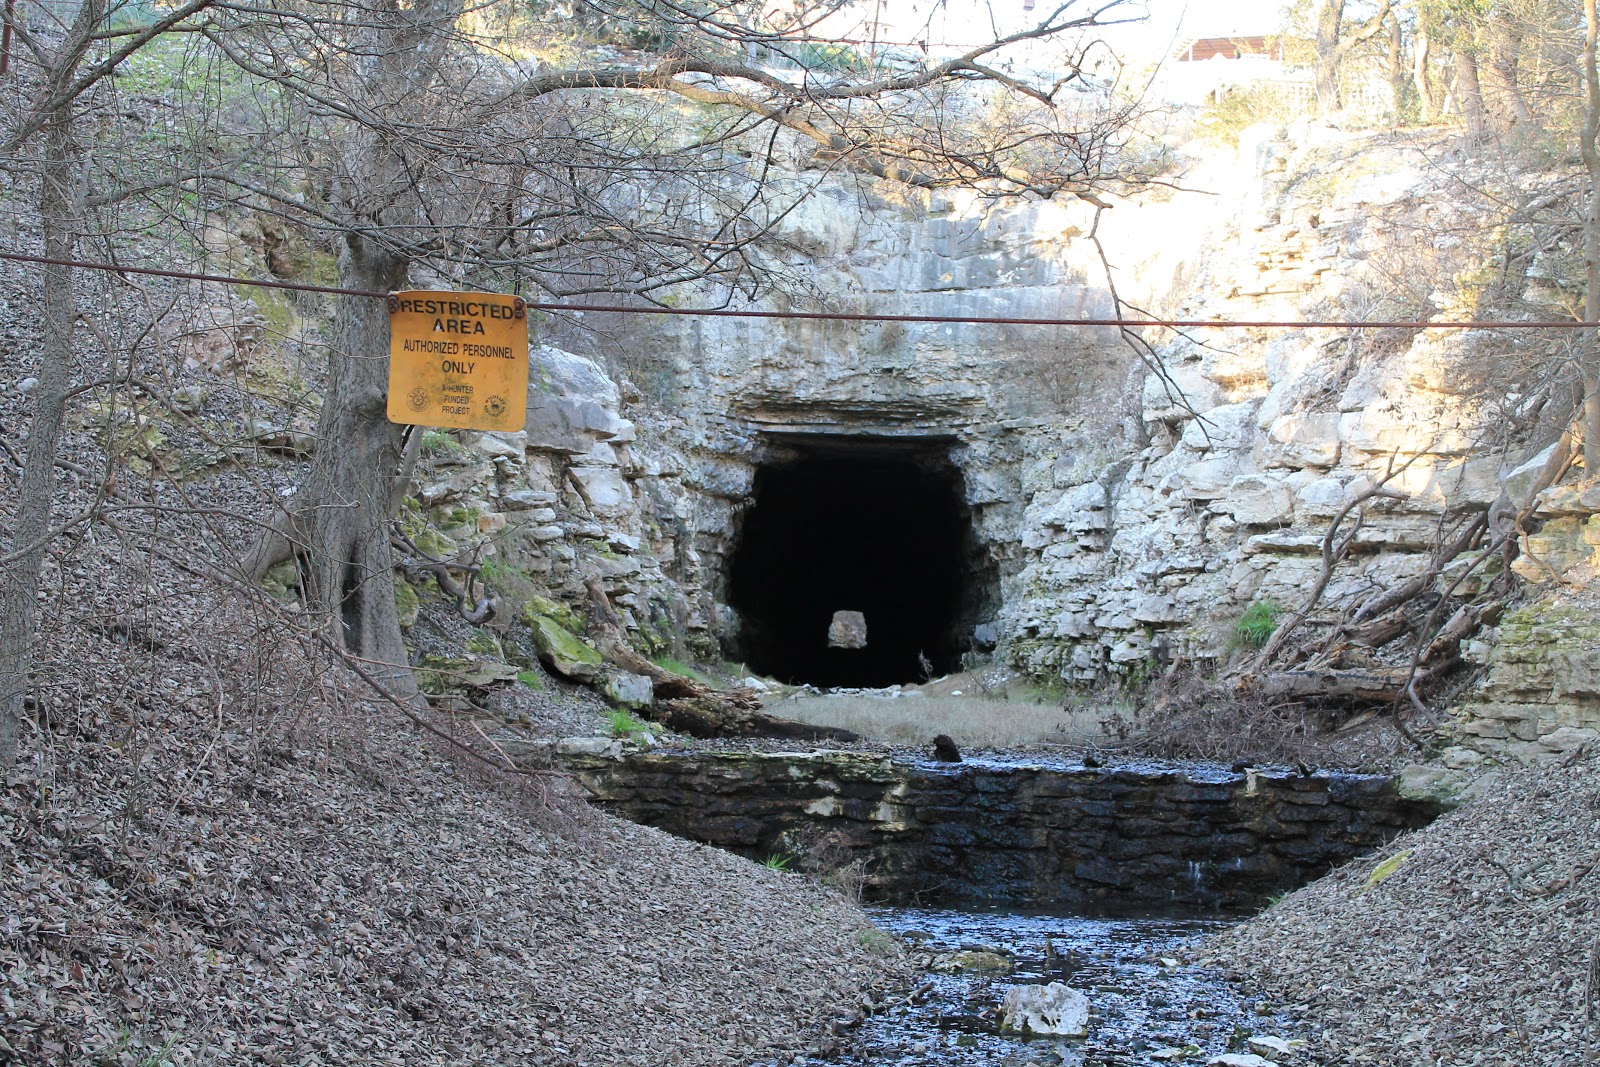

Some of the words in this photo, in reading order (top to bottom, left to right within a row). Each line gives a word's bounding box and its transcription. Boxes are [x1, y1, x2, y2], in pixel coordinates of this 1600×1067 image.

[401, 300, 514, 320] RESTRICTED
[433, 318, 485, 335] AREA
[403, 339, 459, 355] AUTHORIZED
[463, 343, 515, 359] PERSONNEL
[442, 360, 475, 374] ONLY
[448, 385, 474, 394] HUNTER
[444, 395, 469, 404] FUNDED
[441, 406, 470, 415] PROJECT
